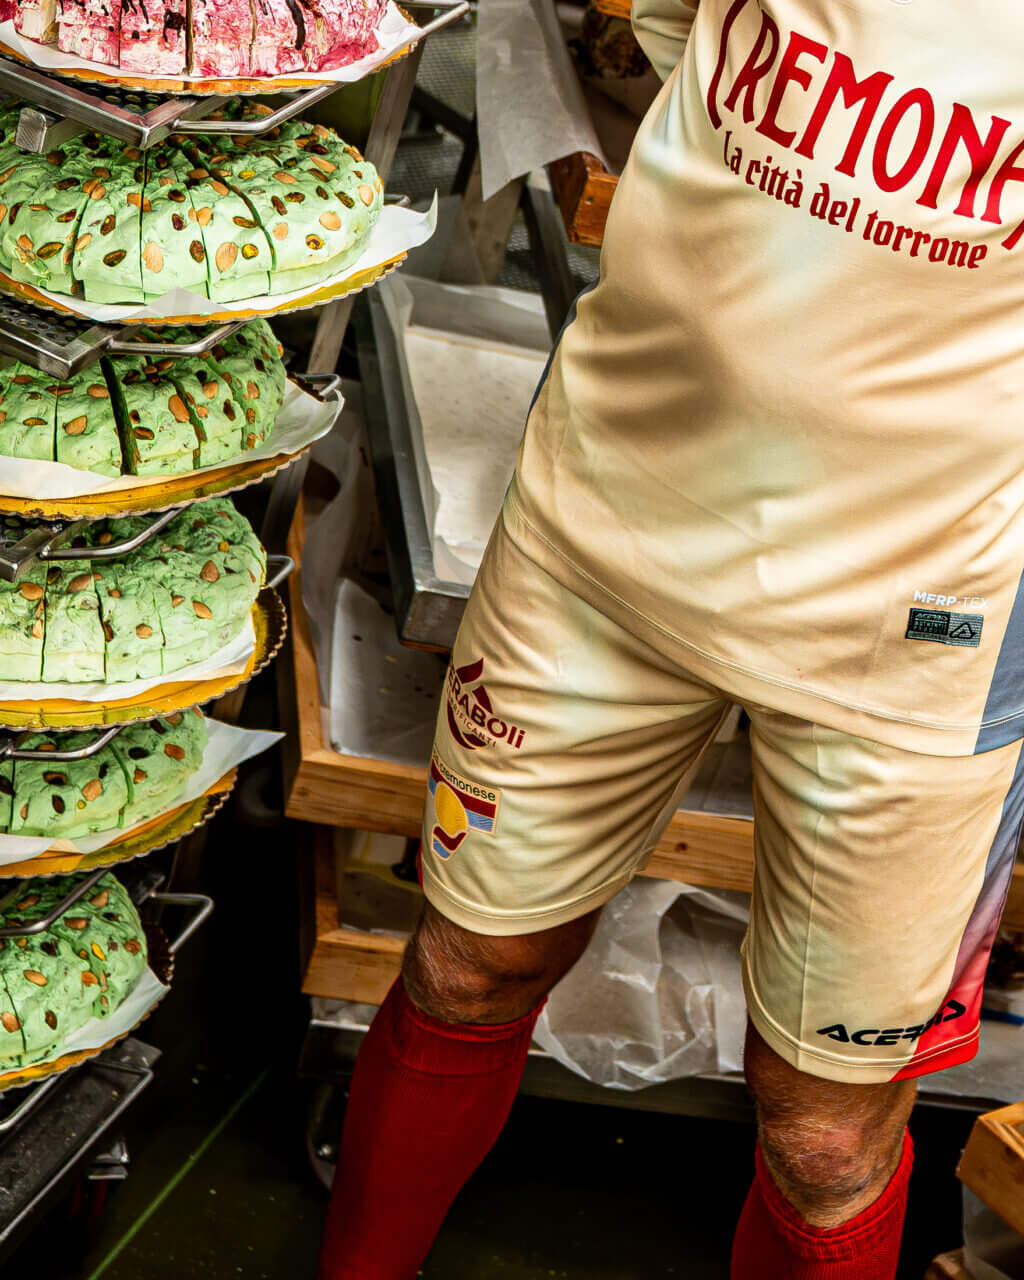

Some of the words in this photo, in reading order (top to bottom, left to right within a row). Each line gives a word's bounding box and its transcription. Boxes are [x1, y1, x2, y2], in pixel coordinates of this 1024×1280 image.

[745, 155, 804, 208] città
[810, 182, 861, 233] del
[863, 209, 989, 270] torrone
